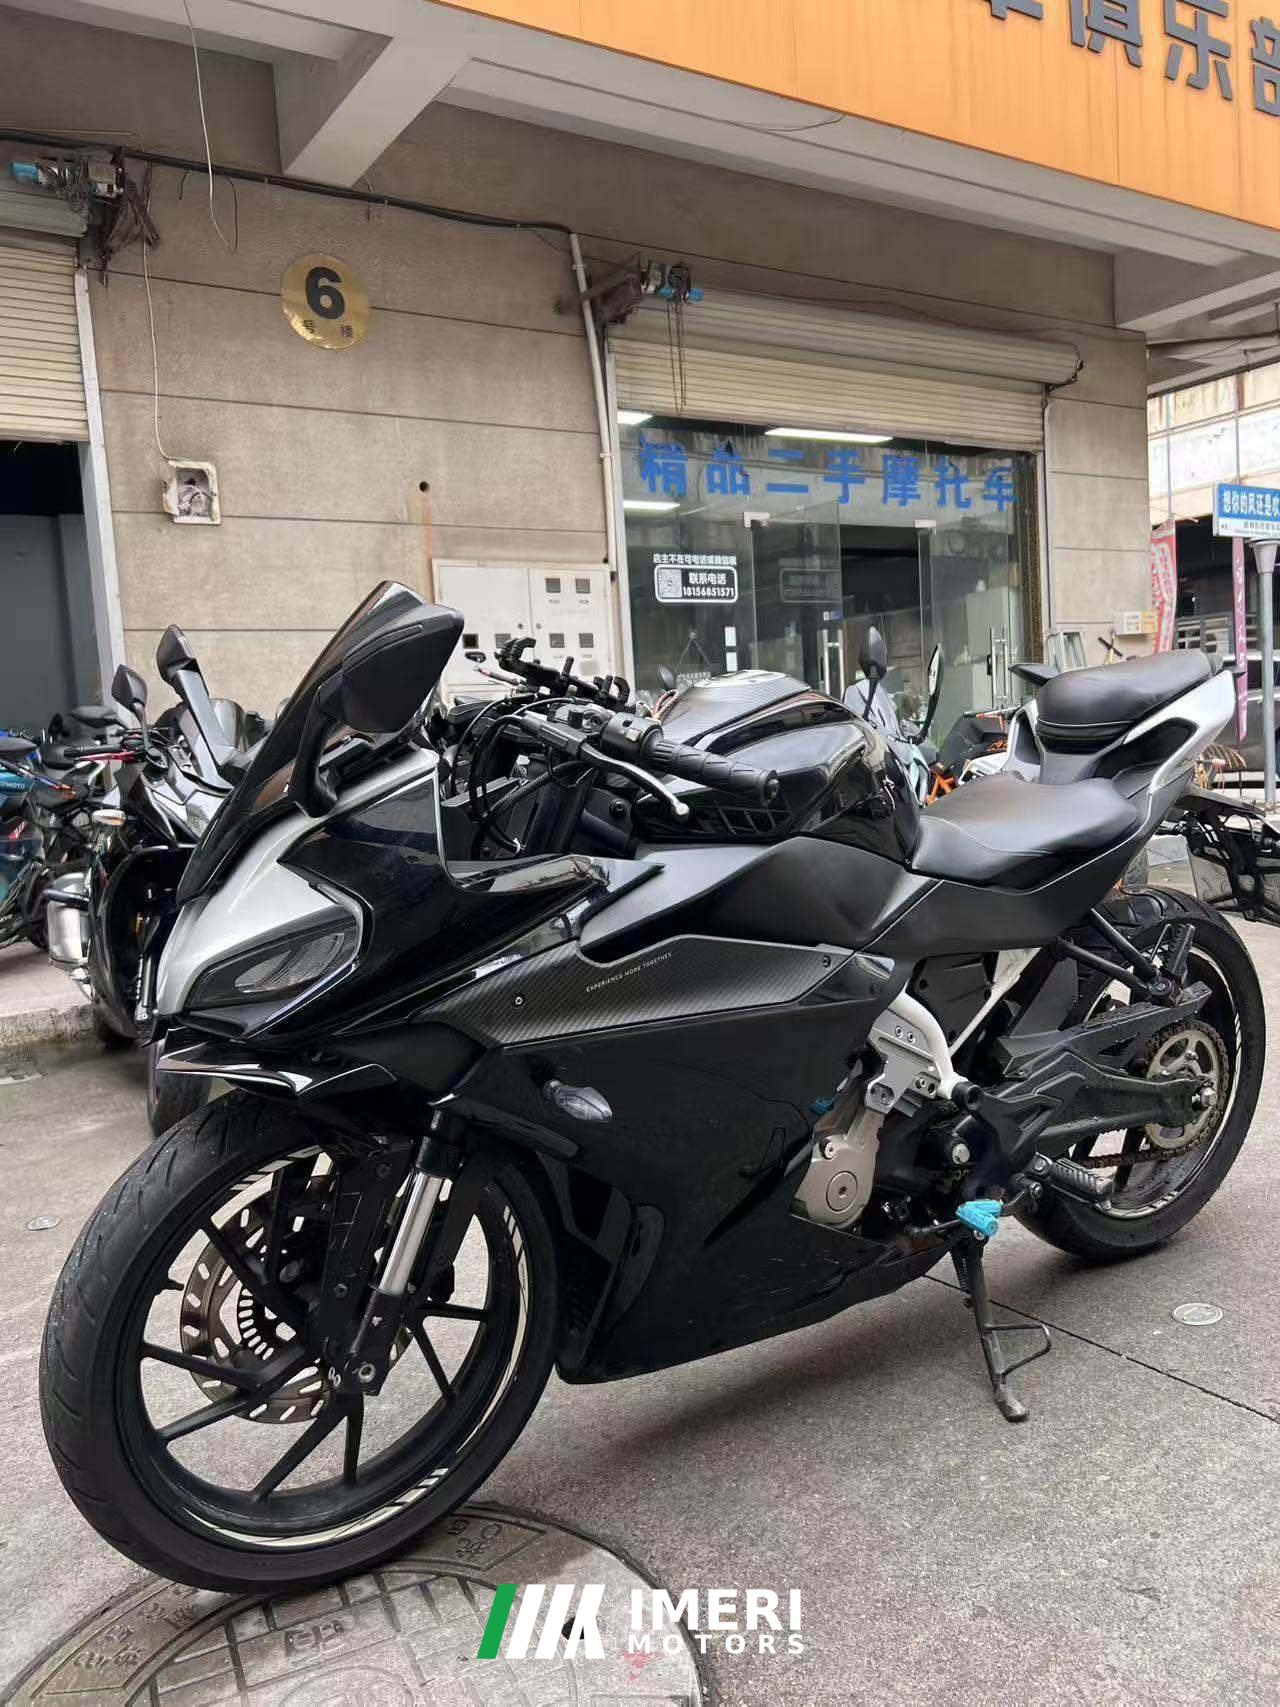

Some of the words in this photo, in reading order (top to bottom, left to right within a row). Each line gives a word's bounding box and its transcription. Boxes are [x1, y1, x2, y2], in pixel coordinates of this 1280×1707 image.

[305, 266, 346, 320] 6
[638, 432, 1018, 512] 精品二手摩托车
[682, 586, 735, 597] 18156851571
[688, 572, 727, 585] 联系电话
[586, 973, 623, 993] EXPERIENCE
[624, 965, 641, 977] MORE
[642, 952, 673, 969] TOGETHER
